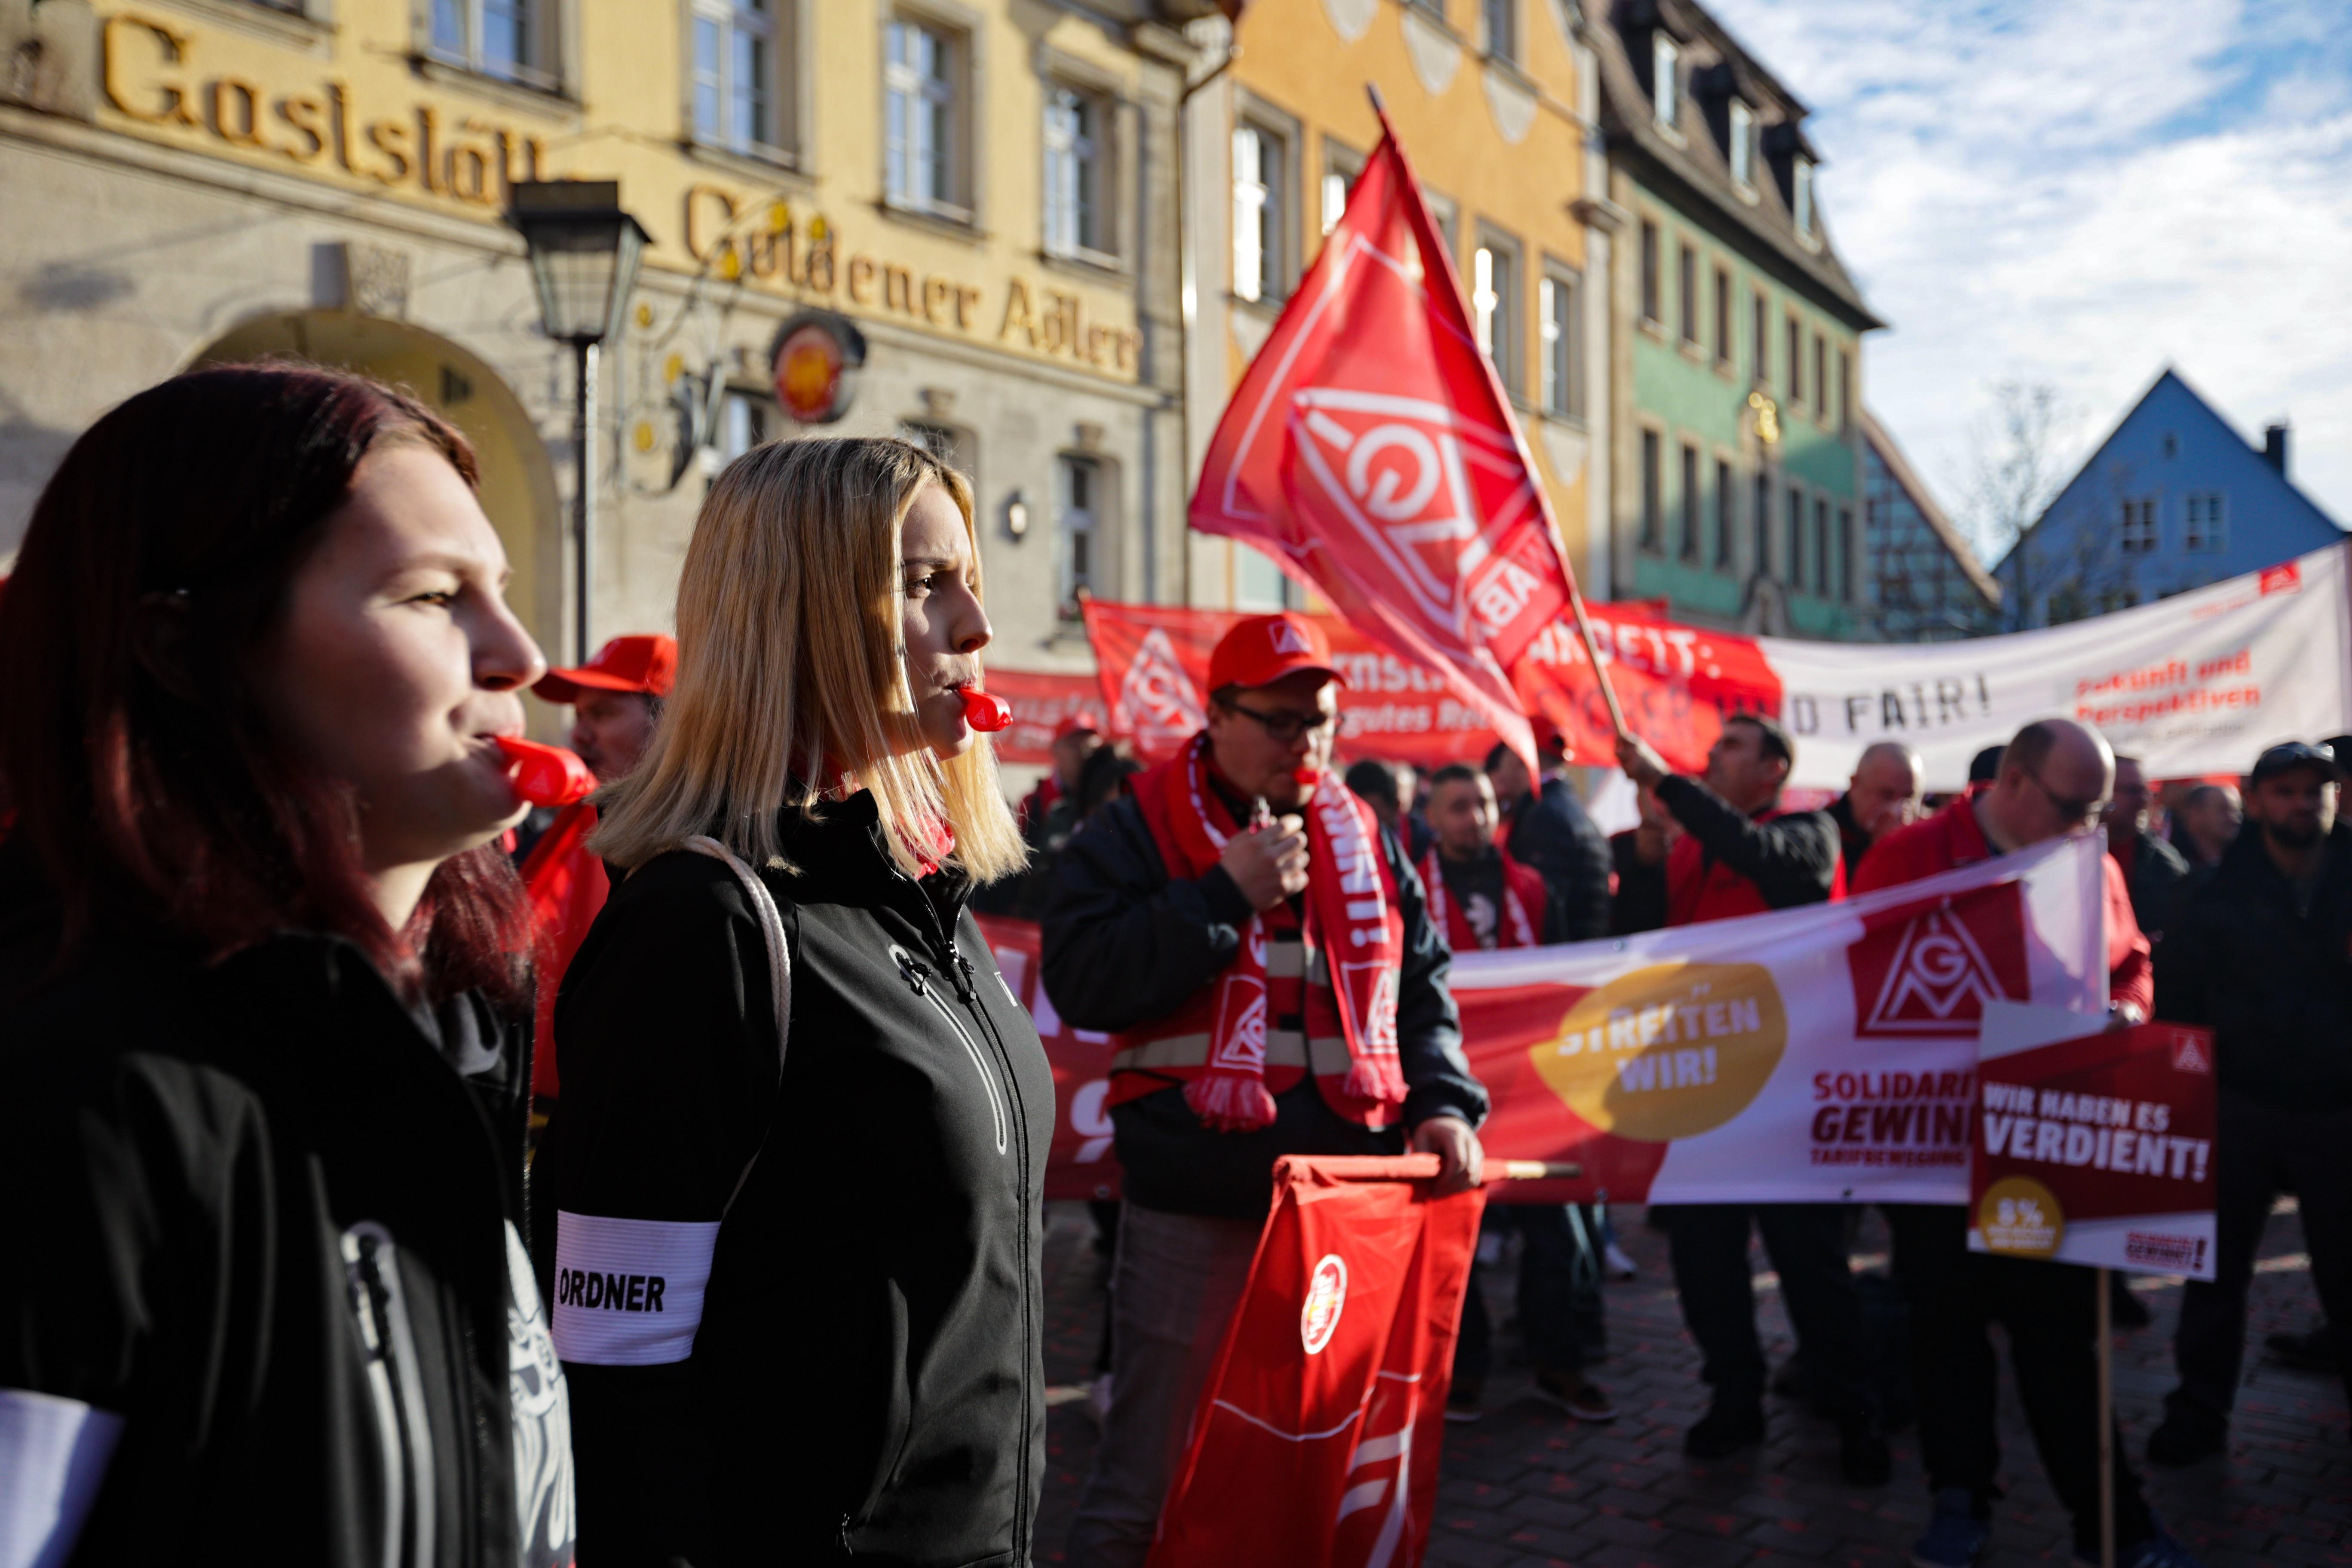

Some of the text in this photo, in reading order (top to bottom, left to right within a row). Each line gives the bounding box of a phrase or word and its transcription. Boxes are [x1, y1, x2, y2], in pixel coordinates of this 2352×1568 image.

[683, 182, 1144, 373] Goldener Adler
[2197, 645, 2251, 680] und
[1844, 668, 1991, 732] FAIR!
[2075, 683, 2262, 726] Perspektiven
[1557, 995, 1761, 1058] STREITEN
[1615, 1045, 1718, 1094] WIR!
[1813, 1070, 1973, 1102] SOLIDARI
[1811, 1104, 1976, 1145] GEWIN
[1982, 1080, 2172, 1133] WIR HABEN ES
[1982, 1112, 2212, 1183] VERDIENT!
[560, 1268, 665, 1312] ORDNER
